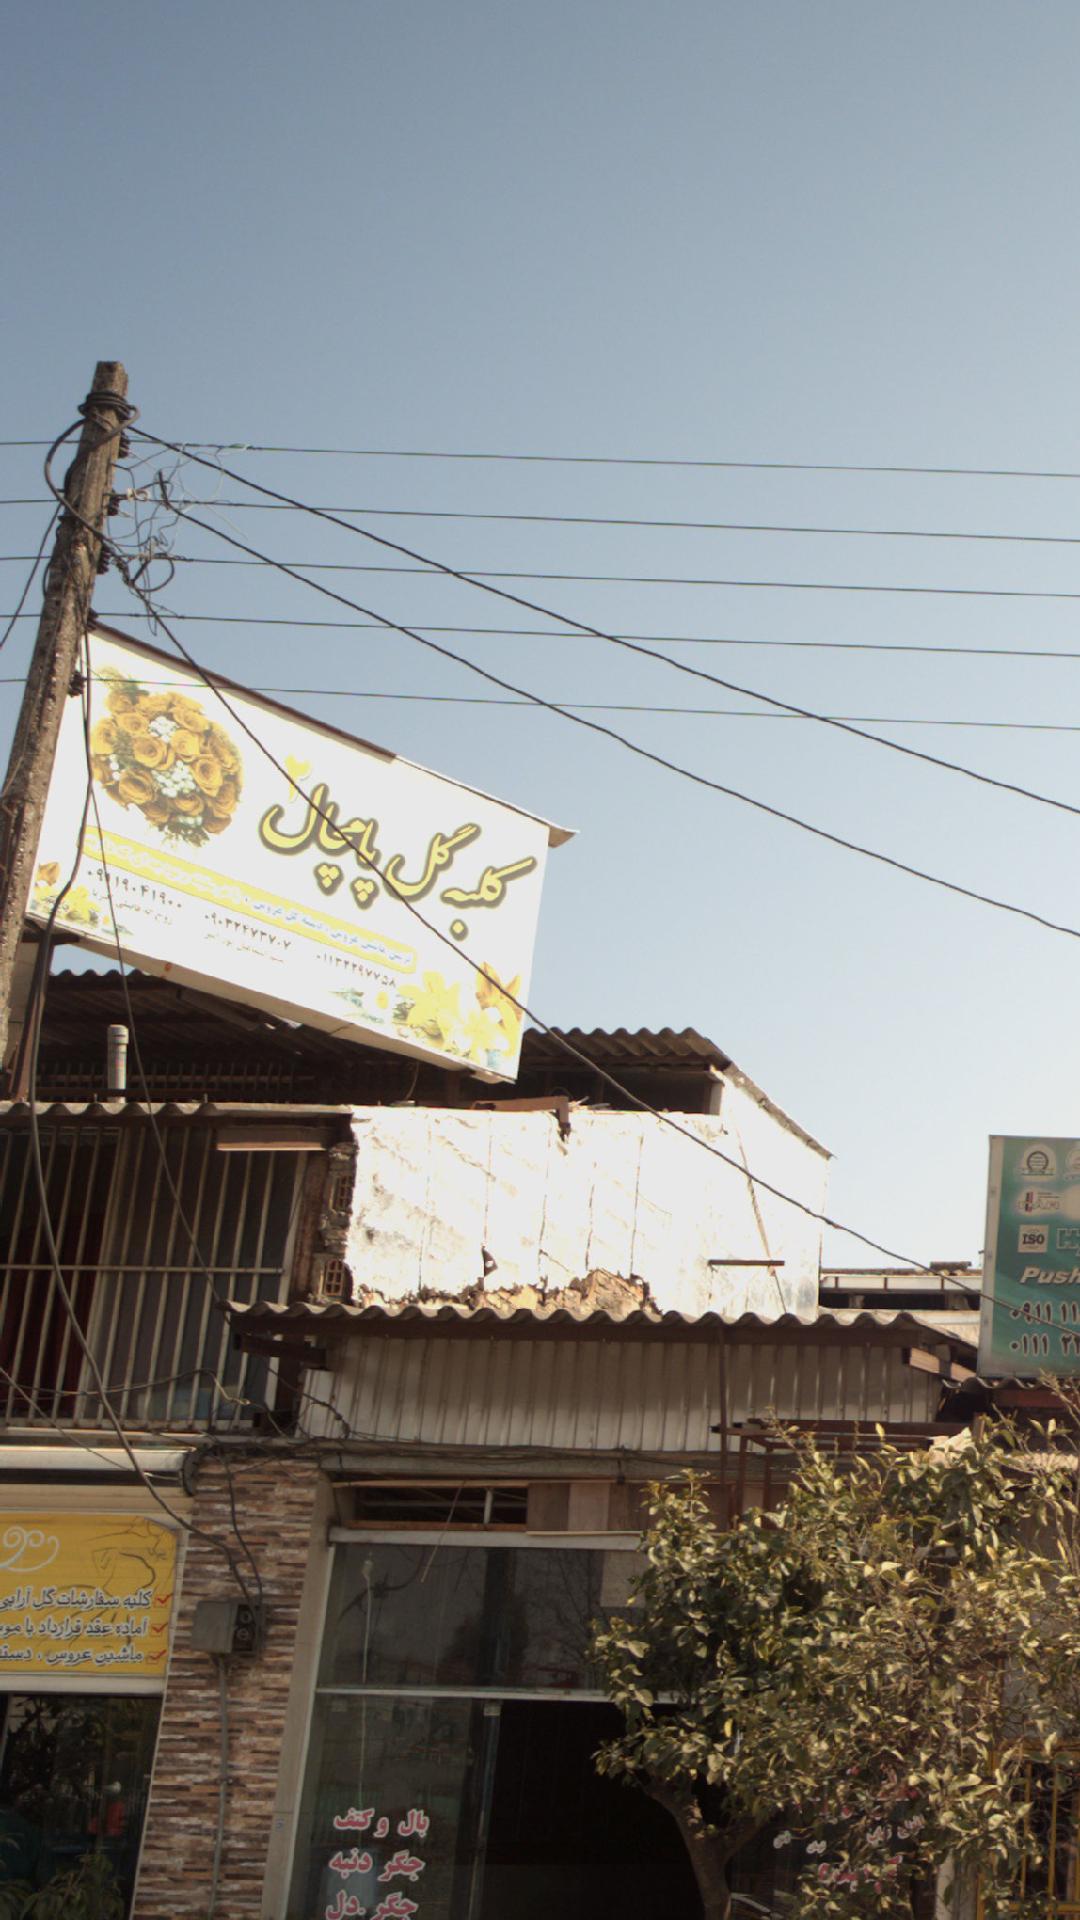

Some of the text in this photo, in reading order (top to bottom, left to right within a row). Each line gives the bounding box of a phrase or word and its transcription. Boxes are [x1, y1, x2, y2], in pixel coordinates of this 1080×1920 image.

[258, 783, 382, 910] پاچال
[383, 822, 481, 902] گل
[441, 856, 537, 942] کلبه
[1022, 1232, 1046, 1245] ISO
[32, 1586, 57, 1610] گل
[56, 1589, 120, 1611] سفارشات
[122, 1588, 153, 1609] کلیه
[23, 1614, 34, 1639] با
[38, 1615, 82, 1640] قرارداد
[86, 1617, 113, 1636] عقد
[45, 1650, 93, 1667] عروس
[95, 1644, 145, 1667] ماشین
[333, 1806, 430, 1839] بال و کتف
[328, 1847, 426, 1882] جگر دنبه
